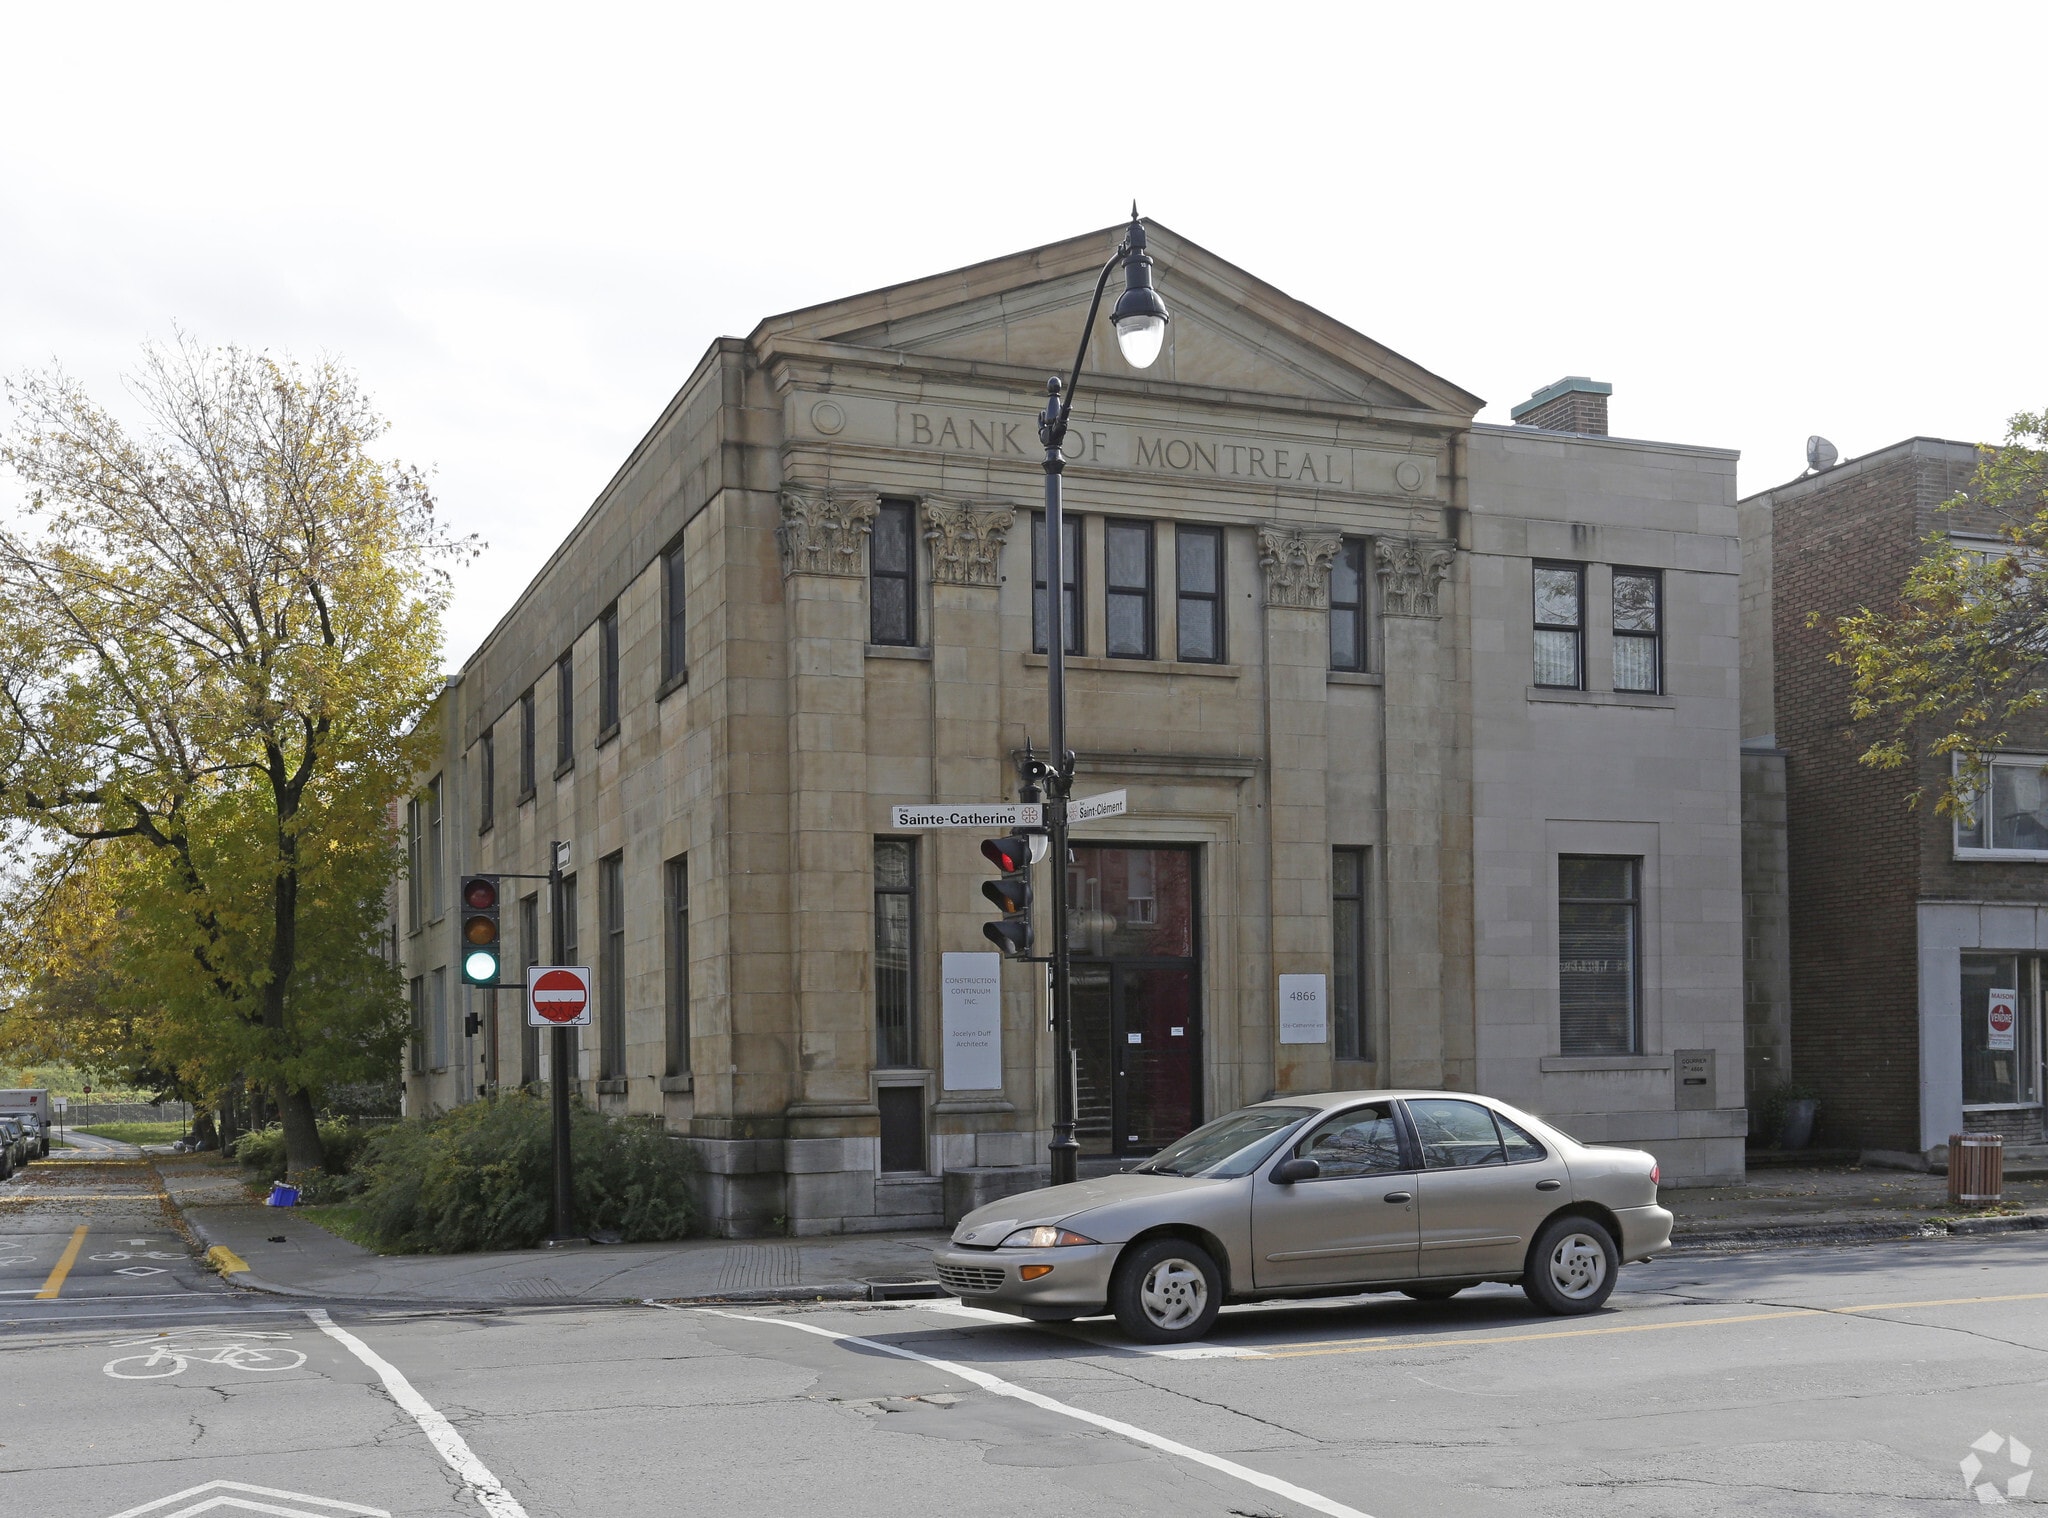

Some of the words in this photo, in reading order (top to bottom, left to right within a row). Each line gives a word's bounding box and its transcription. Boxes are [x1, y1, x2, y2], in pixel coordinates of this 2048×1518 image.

[910, 412, 1025, 455] BANK
[1060, 428, 1108, 462] OF
[1135, 435, 1344, 484] MONTREAL
[1079, 801, 1123, 819] Saint-Clément
[899, 812, 1017, 825] Sainte-Catherine
[1289, 991, 1316, 1001] 4866
[1991, 1013, 2012, 1023] VENDRE
